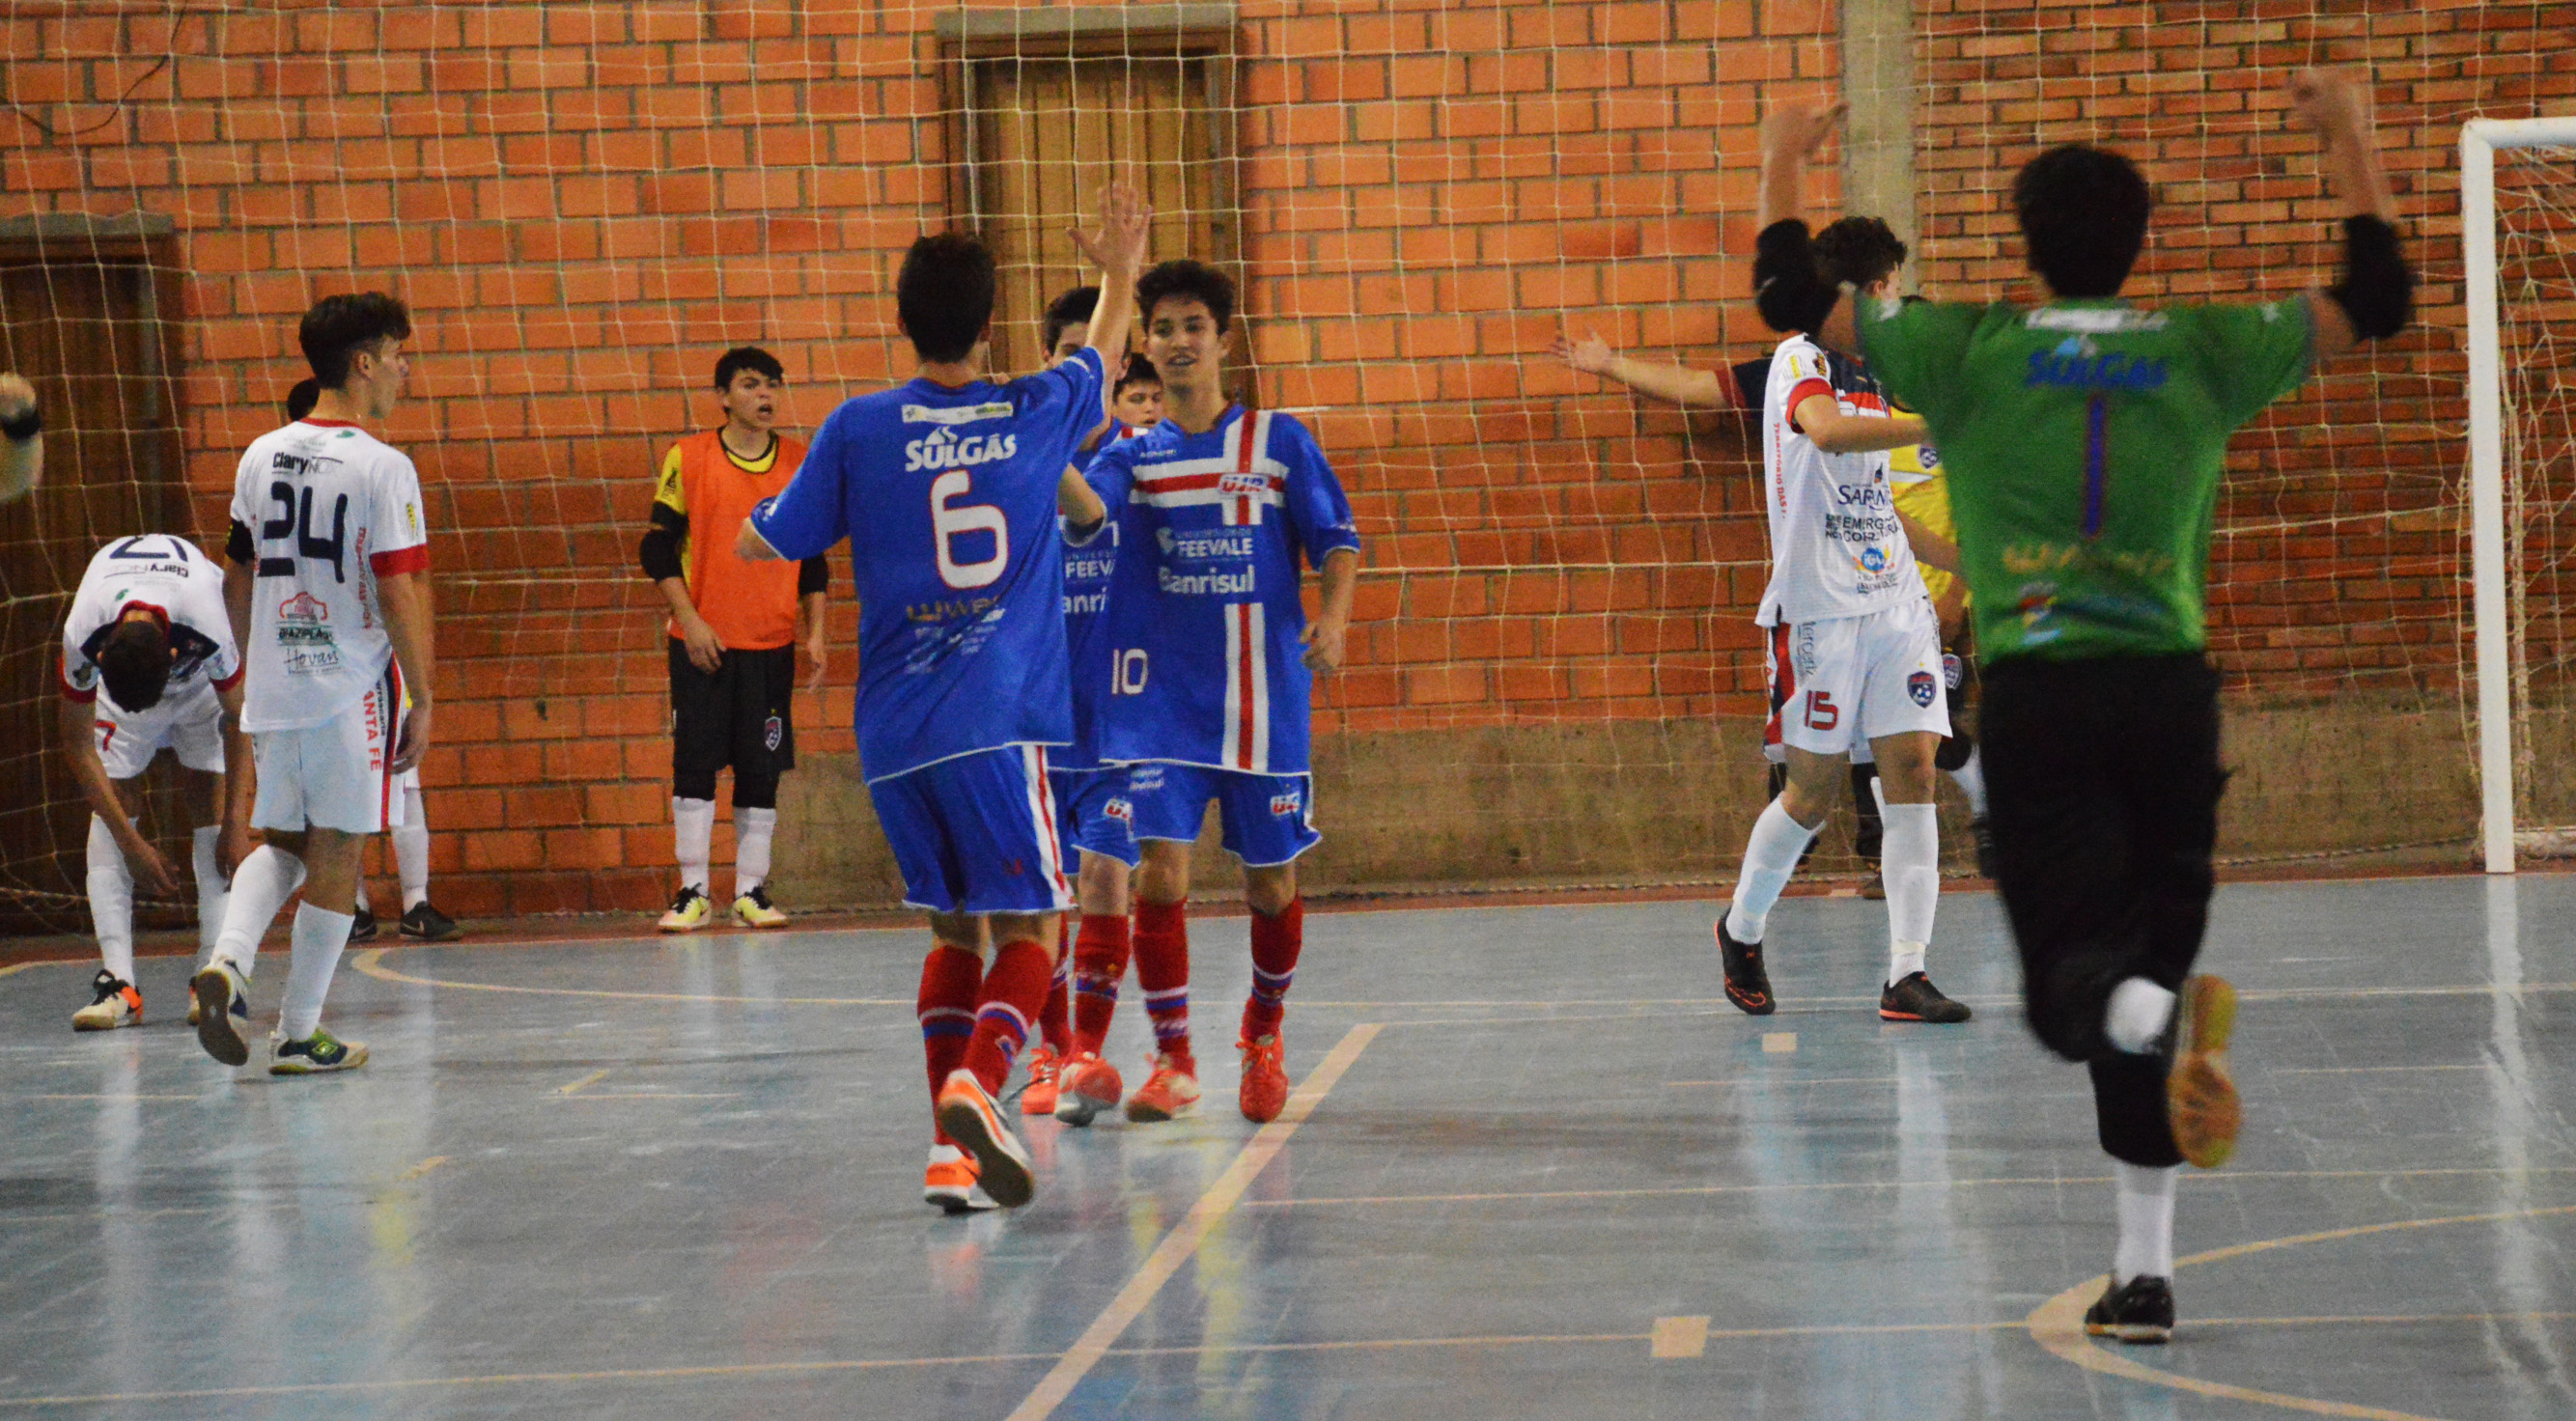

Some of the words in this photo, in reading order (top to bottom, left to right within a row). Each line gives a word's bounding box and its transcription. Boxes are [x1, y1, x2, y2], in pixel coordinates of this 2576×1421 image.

[258, 481, 349, 584] 24
[930, 470, 1008, 589] 6
[1177, 538, 1253, 558] FEEVALE
[1062, 586, 1108, 615] anri
[1159, 564, 1255, 595] Banrisul
[1111, 648, 1149, 695] 10
[363, 690, 378, 741] ANTA
[1805, 689, 1838, 731] 15
